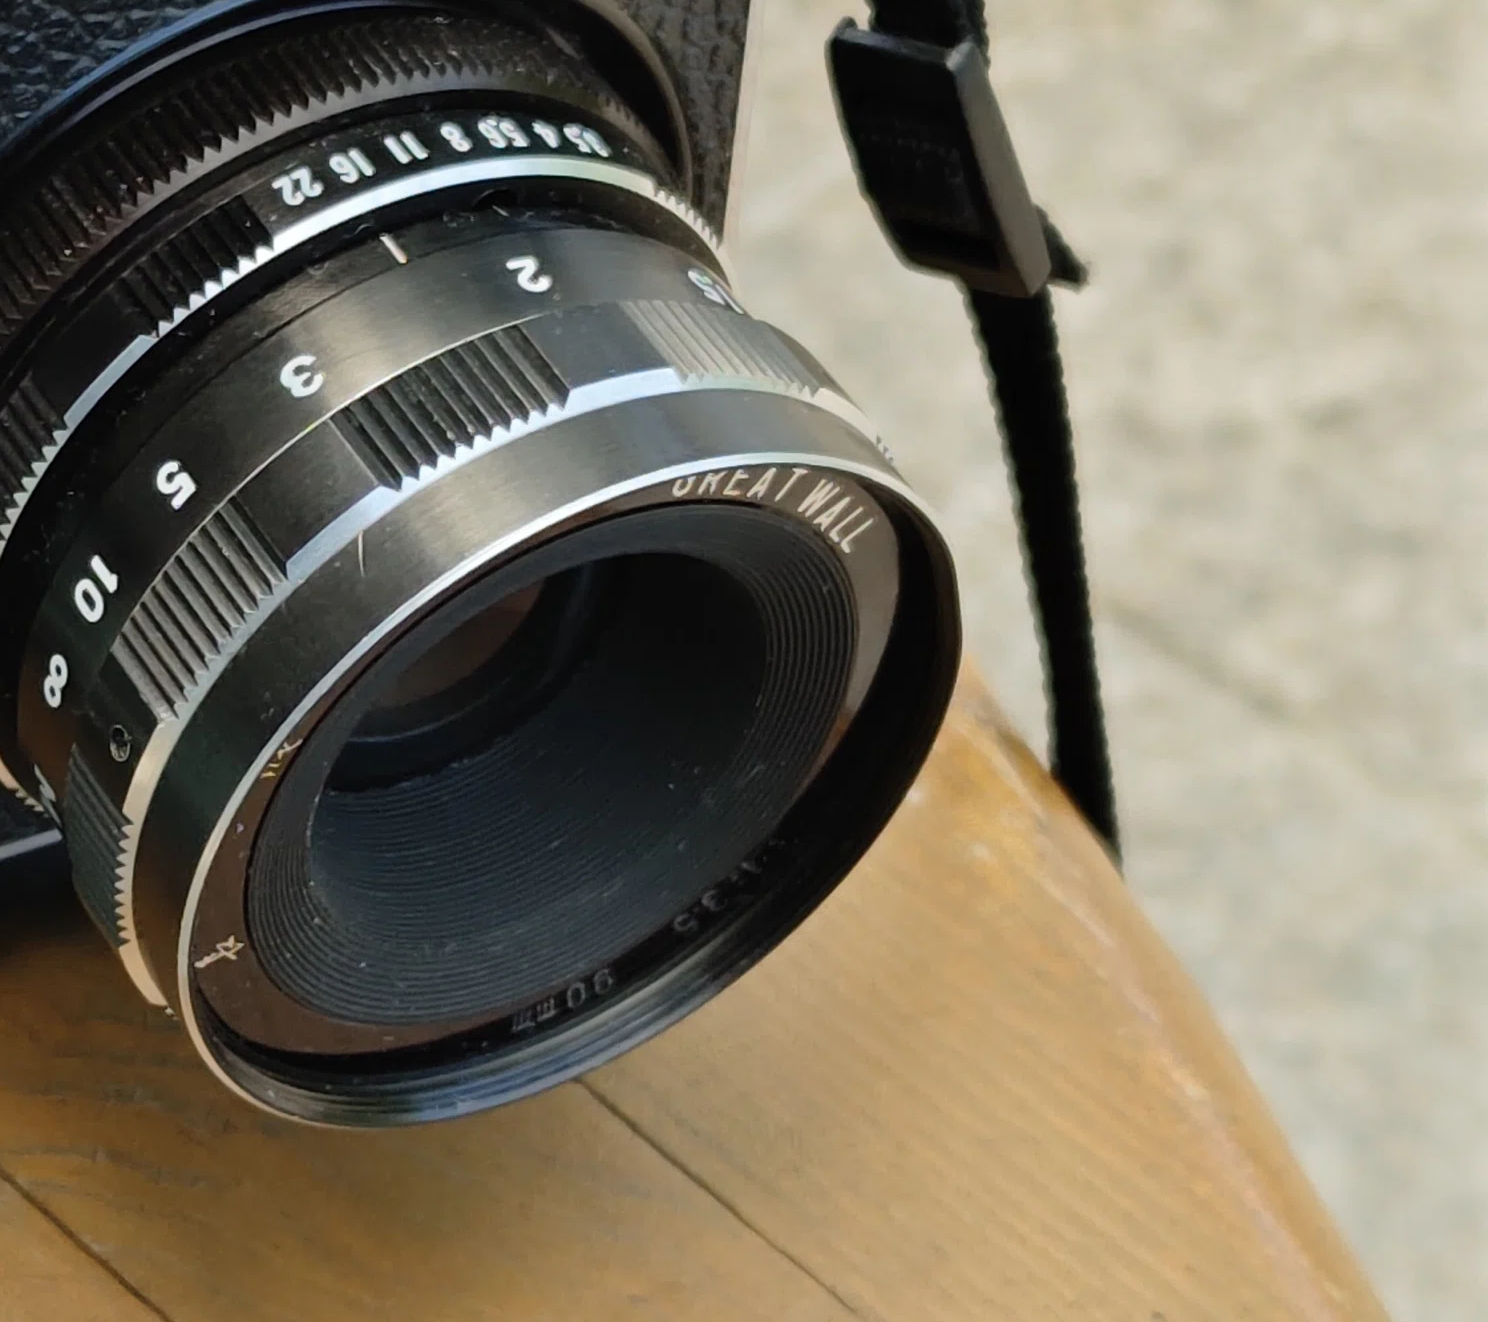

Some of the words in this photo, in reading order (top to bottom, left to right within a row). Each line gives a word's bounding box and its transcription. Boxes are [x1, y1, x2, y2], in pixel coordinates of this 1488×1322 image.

[270, 164, 325, 206] 22
[328, 146, 377, 185] 16
[383, 130, 431, 165] 11
[439, 121, 473, 152] 8
[531, 119, 561, 148] 4
[505, 255, 553, 293] 2
[279, 355, 325, 398] 3
[156, 460, 198, 511] 5
[671, 467, 812, 503] GREAT
[796, 478, 875, 554] WALL
[74, 554, 119, 624] 10
